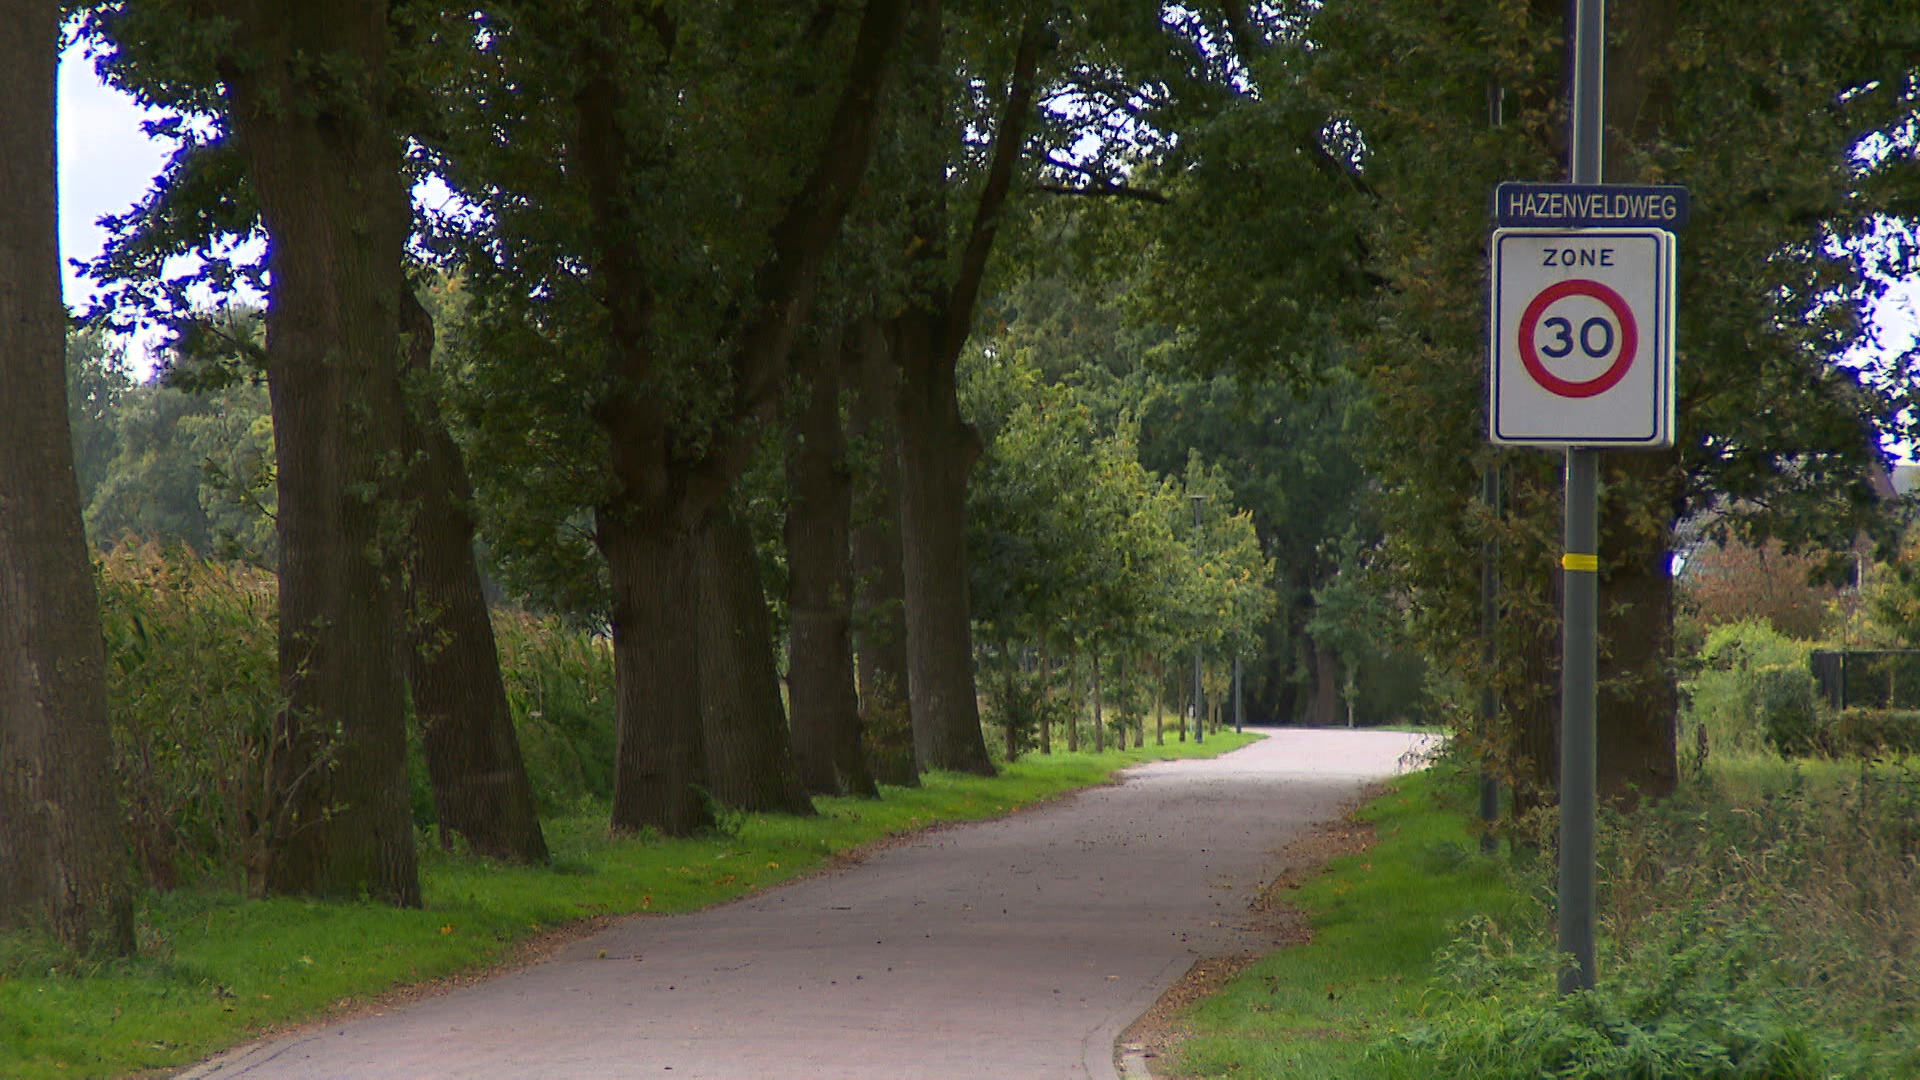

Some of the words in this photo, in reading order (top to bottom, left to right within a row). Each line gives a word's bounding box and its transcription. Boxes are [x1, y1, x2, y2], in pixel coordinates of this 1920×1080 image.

[1510, 193, 1677, 219] HAZENVELDWEG
[1542, 248, 1615, 266] ZONE
[1540, 316, 1614, 358] 30
